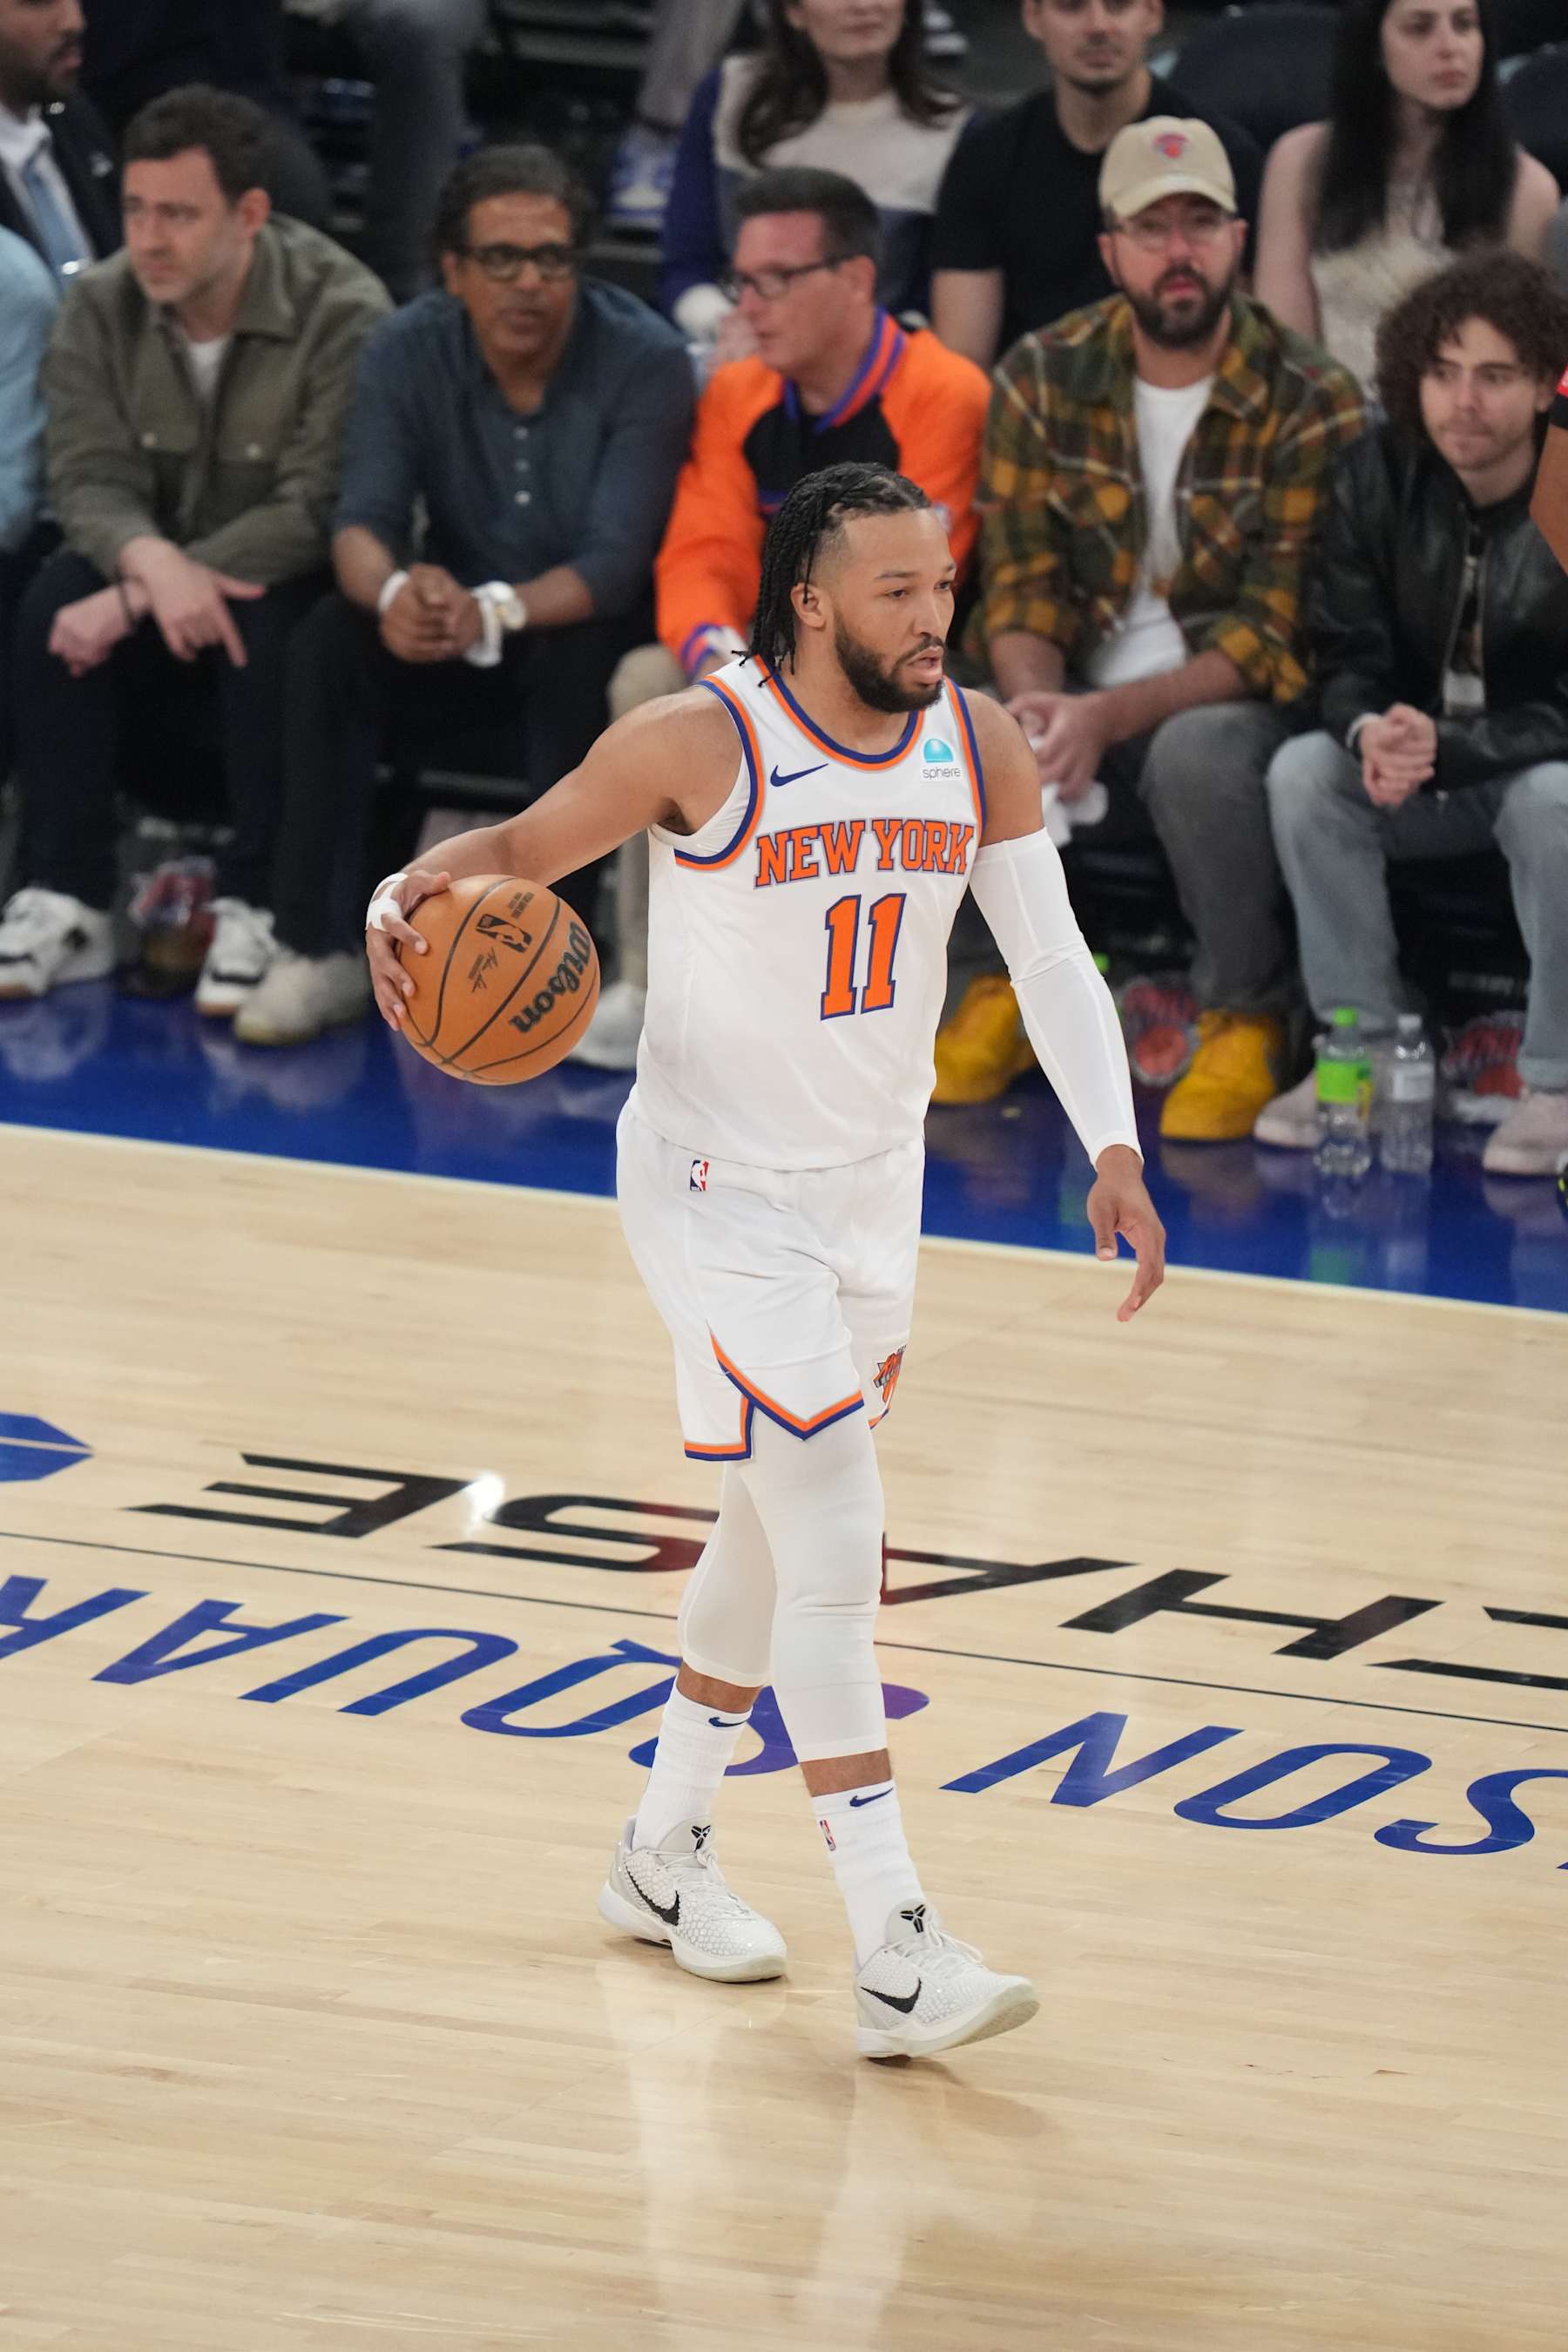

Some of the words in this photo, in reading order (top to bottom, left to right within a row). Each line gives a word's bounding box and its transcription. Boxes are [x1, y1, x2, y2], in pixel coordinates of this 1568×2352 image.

[922, 767, 961, 781] sphere
[754, 819, 866, 889] NEW
[871, 818, 976, 875] YORK
[509, 920, 591, 1034] Wilson
[820, 892, 908, 1021] 11
[940, 1711, 1568, 1870] SON
